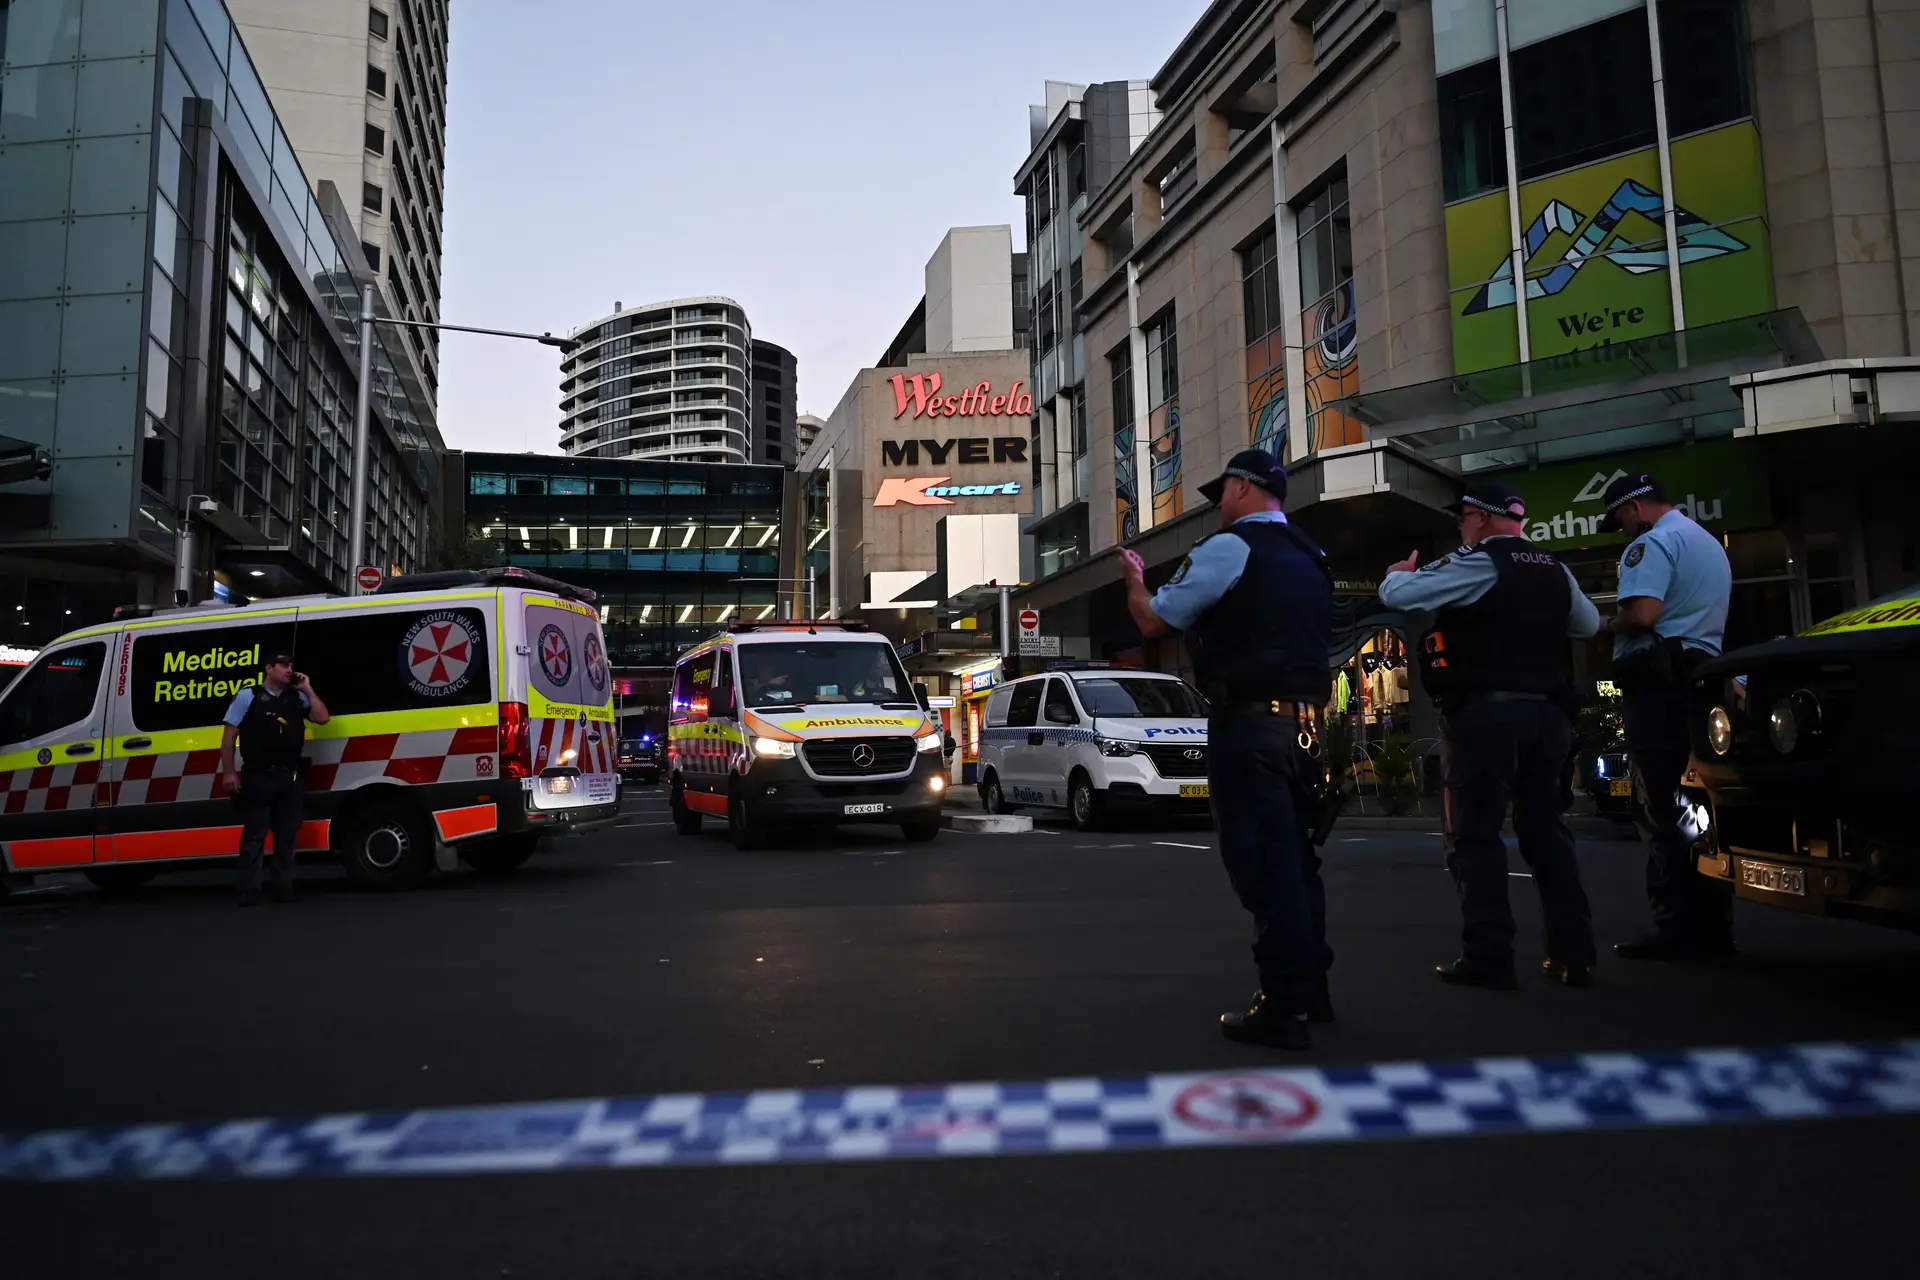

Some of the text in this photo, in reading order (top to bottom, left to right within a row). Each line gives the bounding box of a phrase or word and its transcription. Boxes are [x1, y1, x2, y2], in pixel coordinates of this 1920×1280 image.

[1558, 308, 1644, 337] We're
[882, 437, 1028, 465] MYER
[1511, 552, 1555, 566] POLICE
[402, 610, 481, 648] NEW SOUTH WALES
[163, 644, 260, 673] Medical
[408, 675, 469, 697] AMBULANCE
[546, 704, 578, 719] Emergency
[805, 718, 904, 728] Ambulance
[1144, 727, 1208, 738] Polic
[1013, 786, 1043, 802] Police
